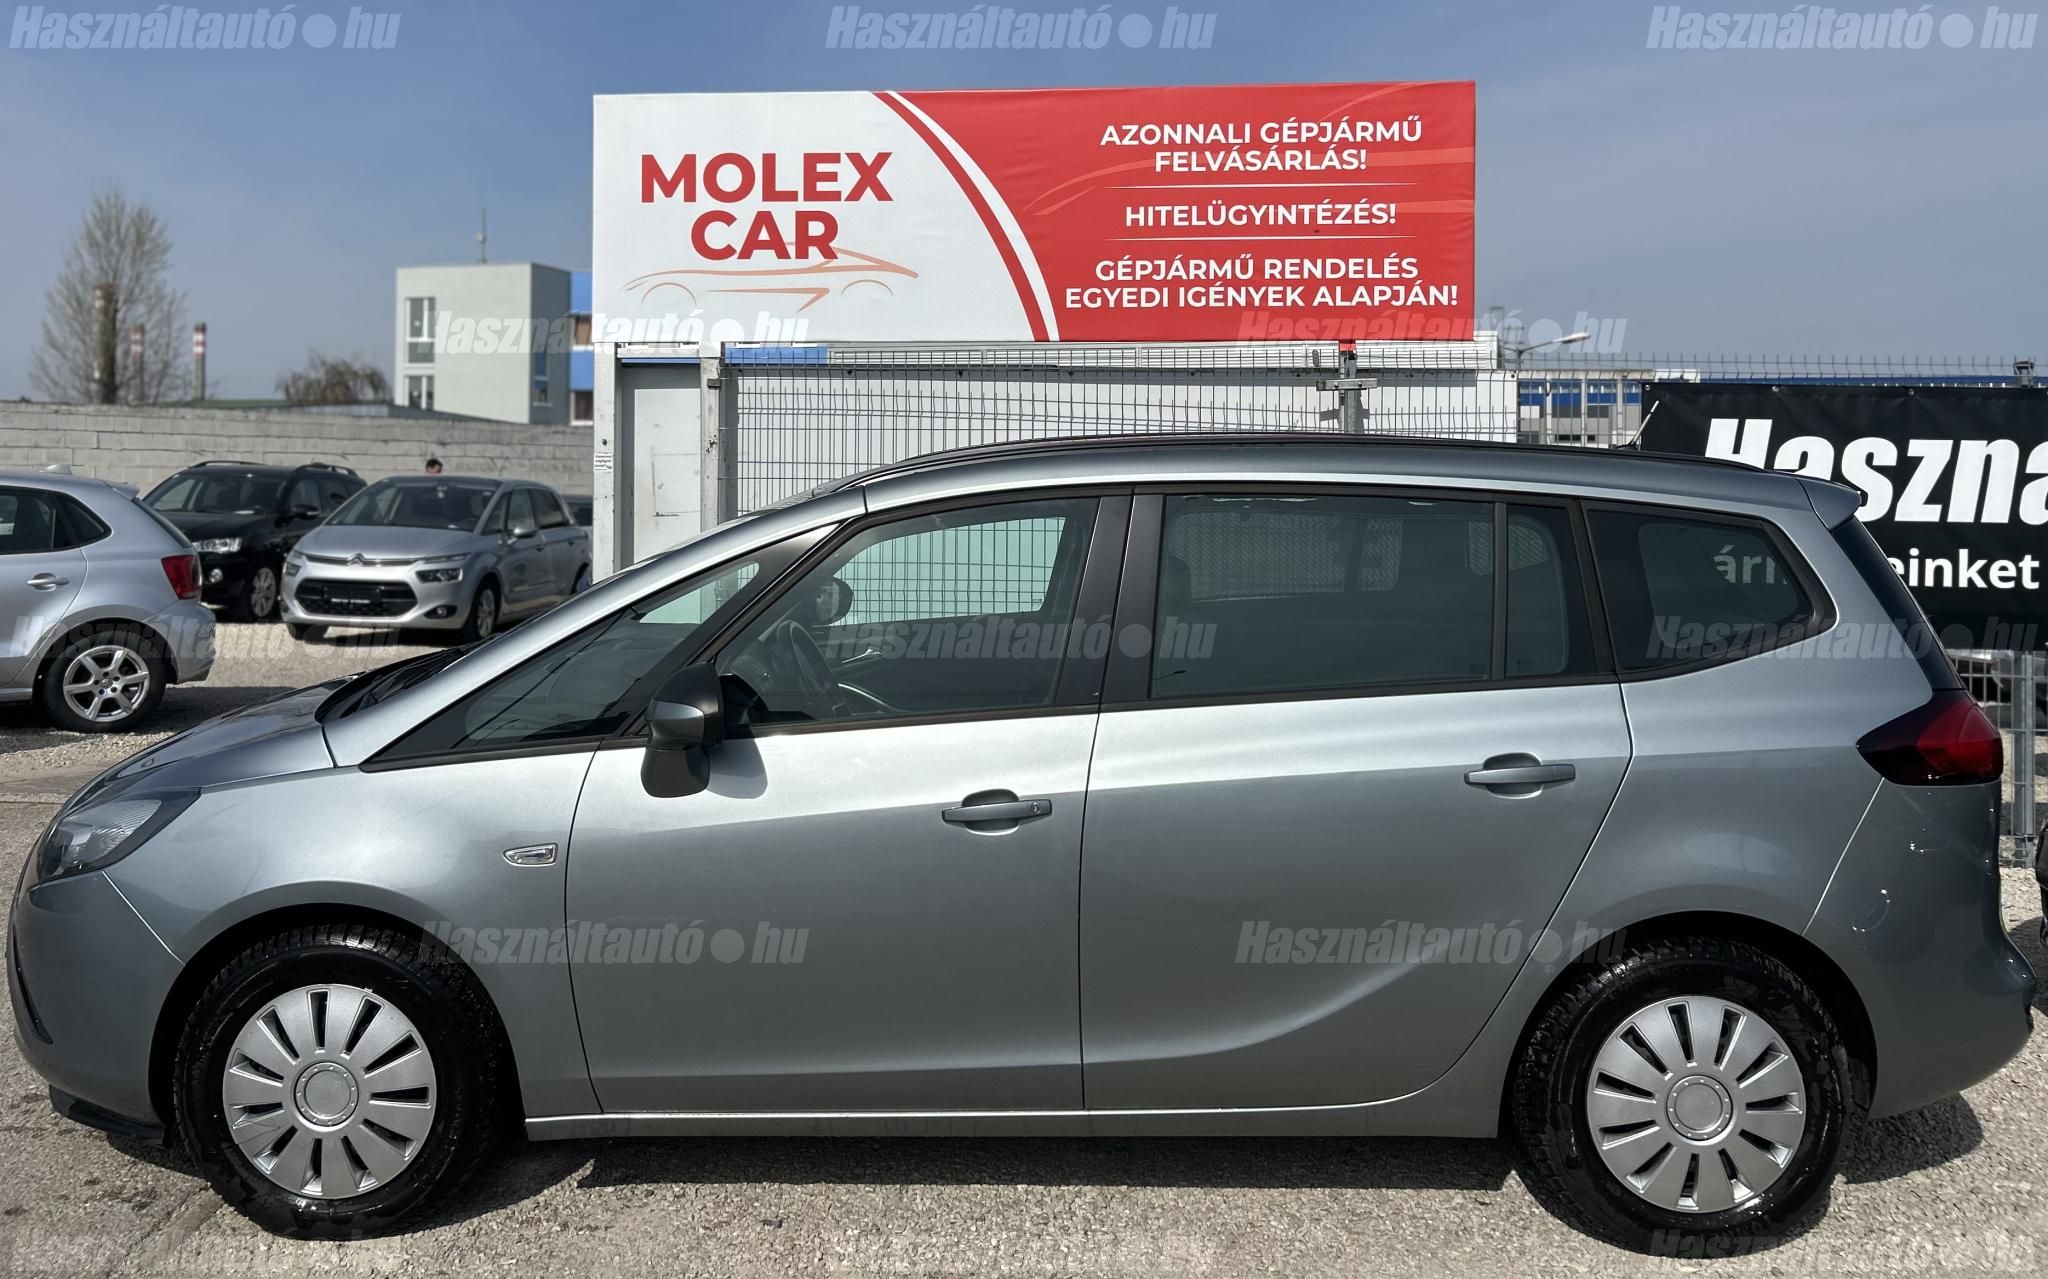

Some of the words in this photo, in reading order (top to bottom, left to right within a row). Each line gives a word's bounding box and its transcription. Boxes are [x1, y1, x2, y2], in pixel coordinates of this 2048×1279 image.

[1100, 121, 1251, 146] AZONNALI
[1260, 115, 1422, 143] GÉPJÁRMŰ
[1155, 144, 1367, 173] FELVÁSÁRLÁS!
[641, 152, 893, 203] MOLEX
[1125, 198, 1396, 227] HITELÜGYINTÉZÉS!
[691, 210, 839, 260] CAR
[1095, 253, 1254, 281] GÉPJÁRMŰ
[1263, 252, 1418, 279] RENDELÉS
[1065, 286, 1169, 309] EGYEDI
[1178, 281, 1305, 308] IGÉNYEK
[1312, 278, 1458, 307] ALAPJÁN!
